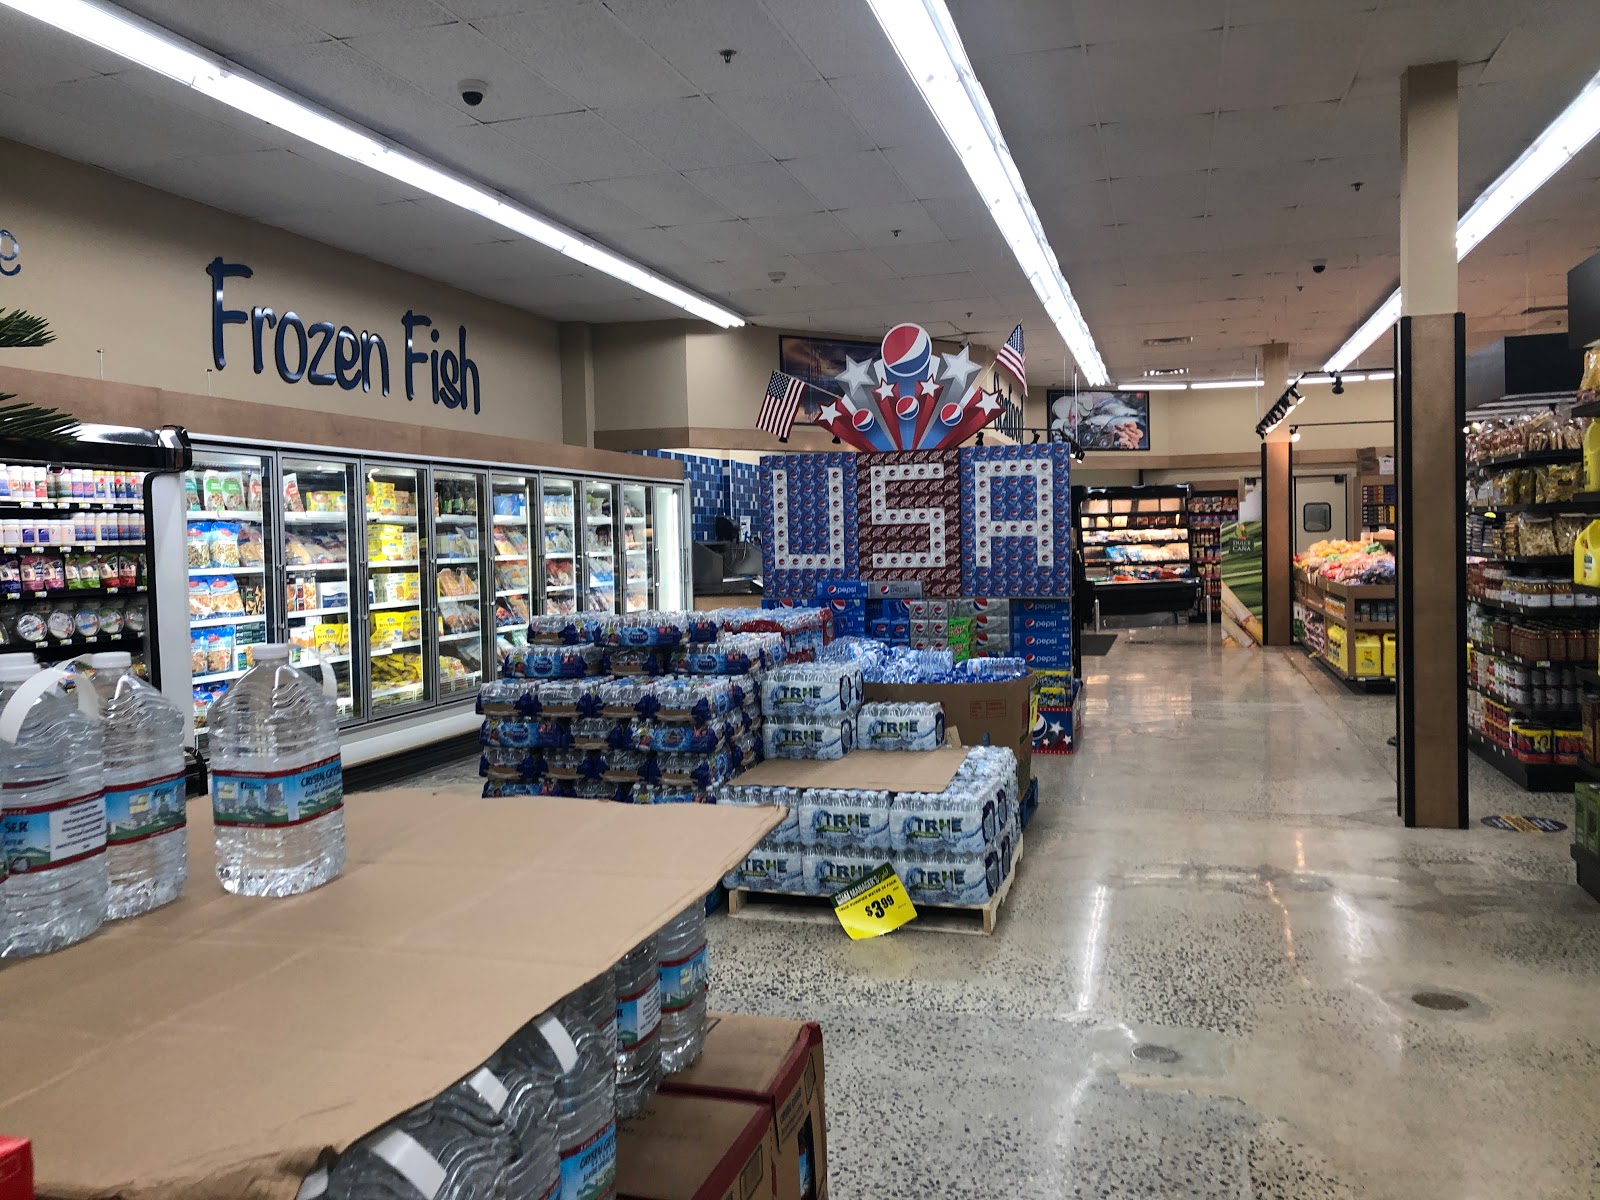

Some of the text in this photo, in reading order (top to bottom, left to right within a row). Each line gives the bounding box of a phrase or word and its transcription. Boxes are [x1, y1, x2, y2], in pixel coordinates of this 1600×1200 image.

[206, 256, 481, 415] Frozen Fish
[837, 586, 857, 594] pepsi
[889, 585, 910, 593] pepsi
[1034, 602, 1056, 611] pepsi
[1035, 619, 1057, 628] pepsi
[1036, 637, 1058, 645] pepsi
[1036, 654, 1058, 663] pepsi
